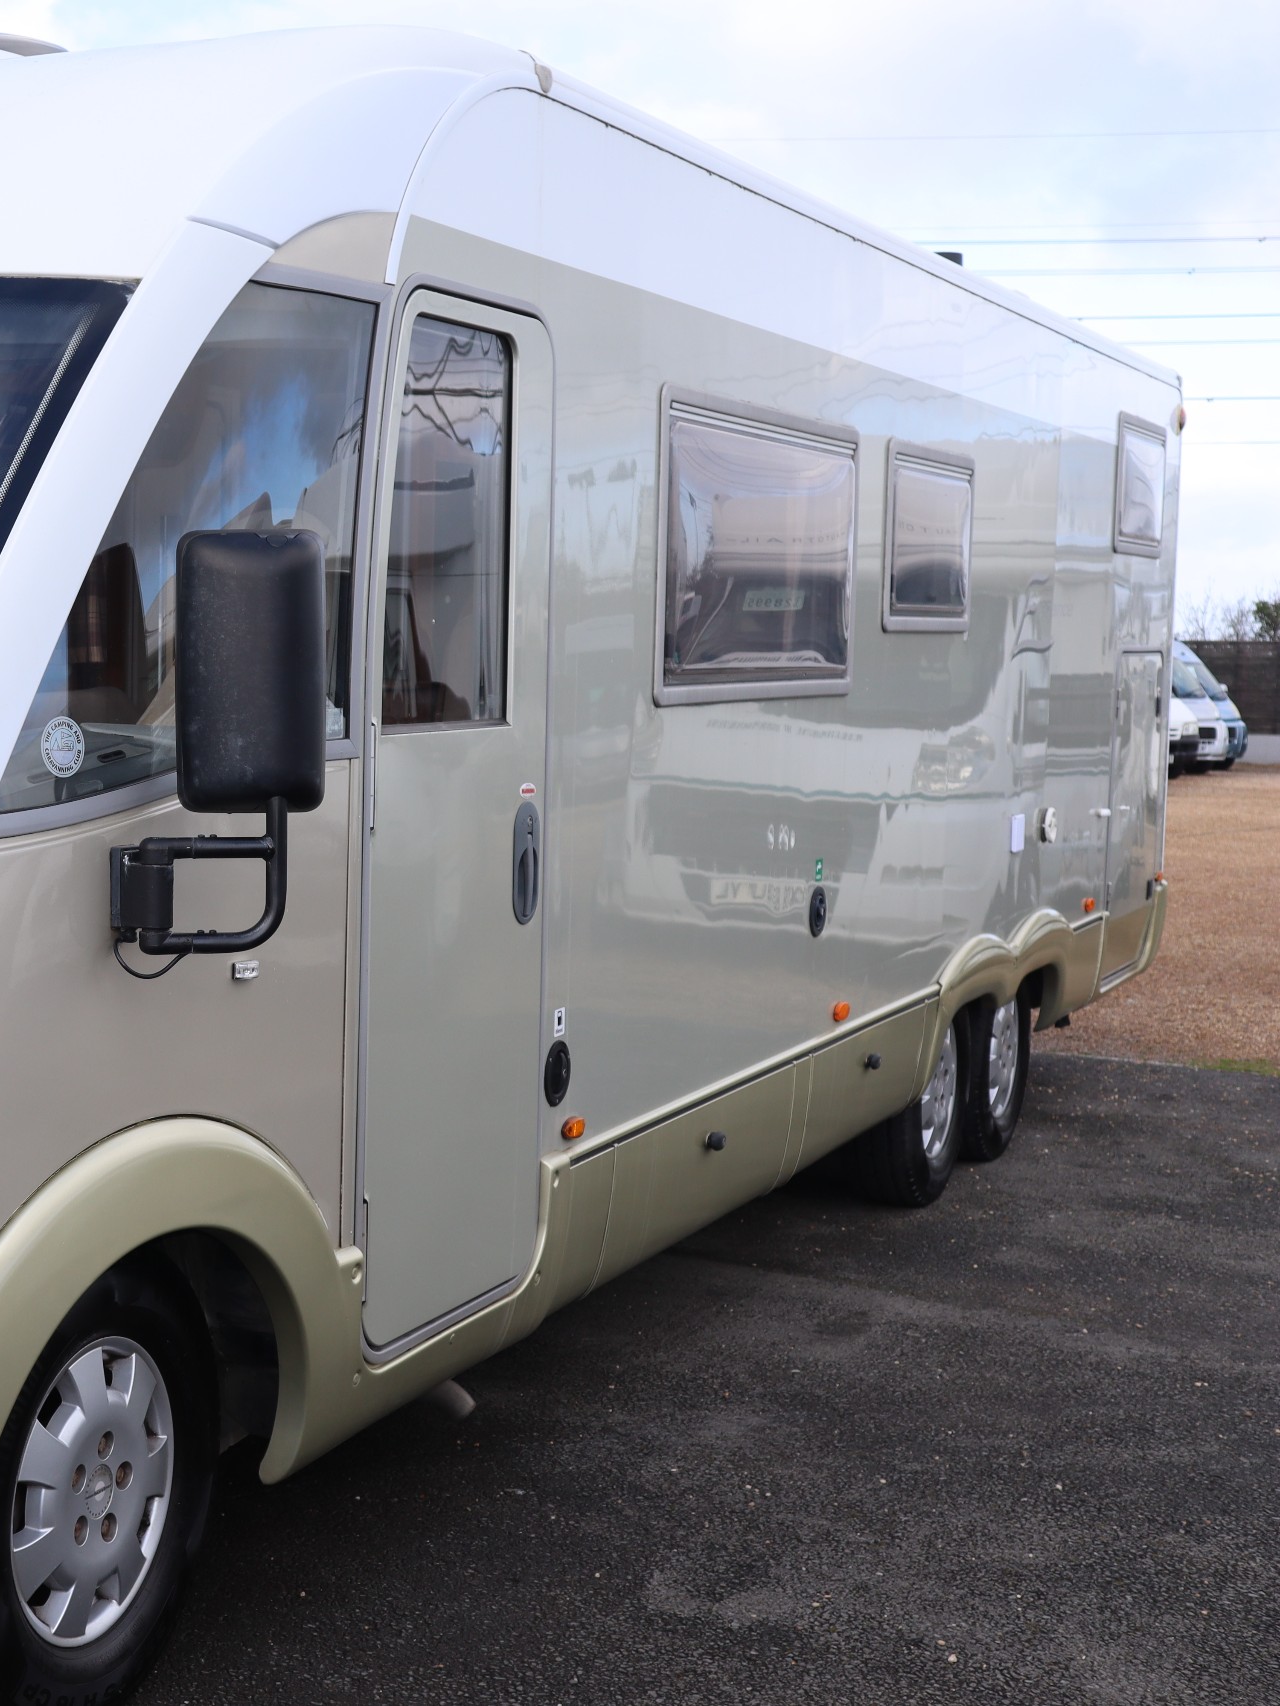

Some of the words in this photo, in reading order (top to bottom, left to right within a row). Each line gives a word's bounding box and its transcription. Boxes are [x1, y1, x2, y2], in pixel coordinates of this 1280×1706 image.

[50, 720, 74, 731] CAMPING
[73, 730, 82, 744] AND
[44, 747, 74, 773] CARAVANNING
[73, 749, 82, 765] CLUB
